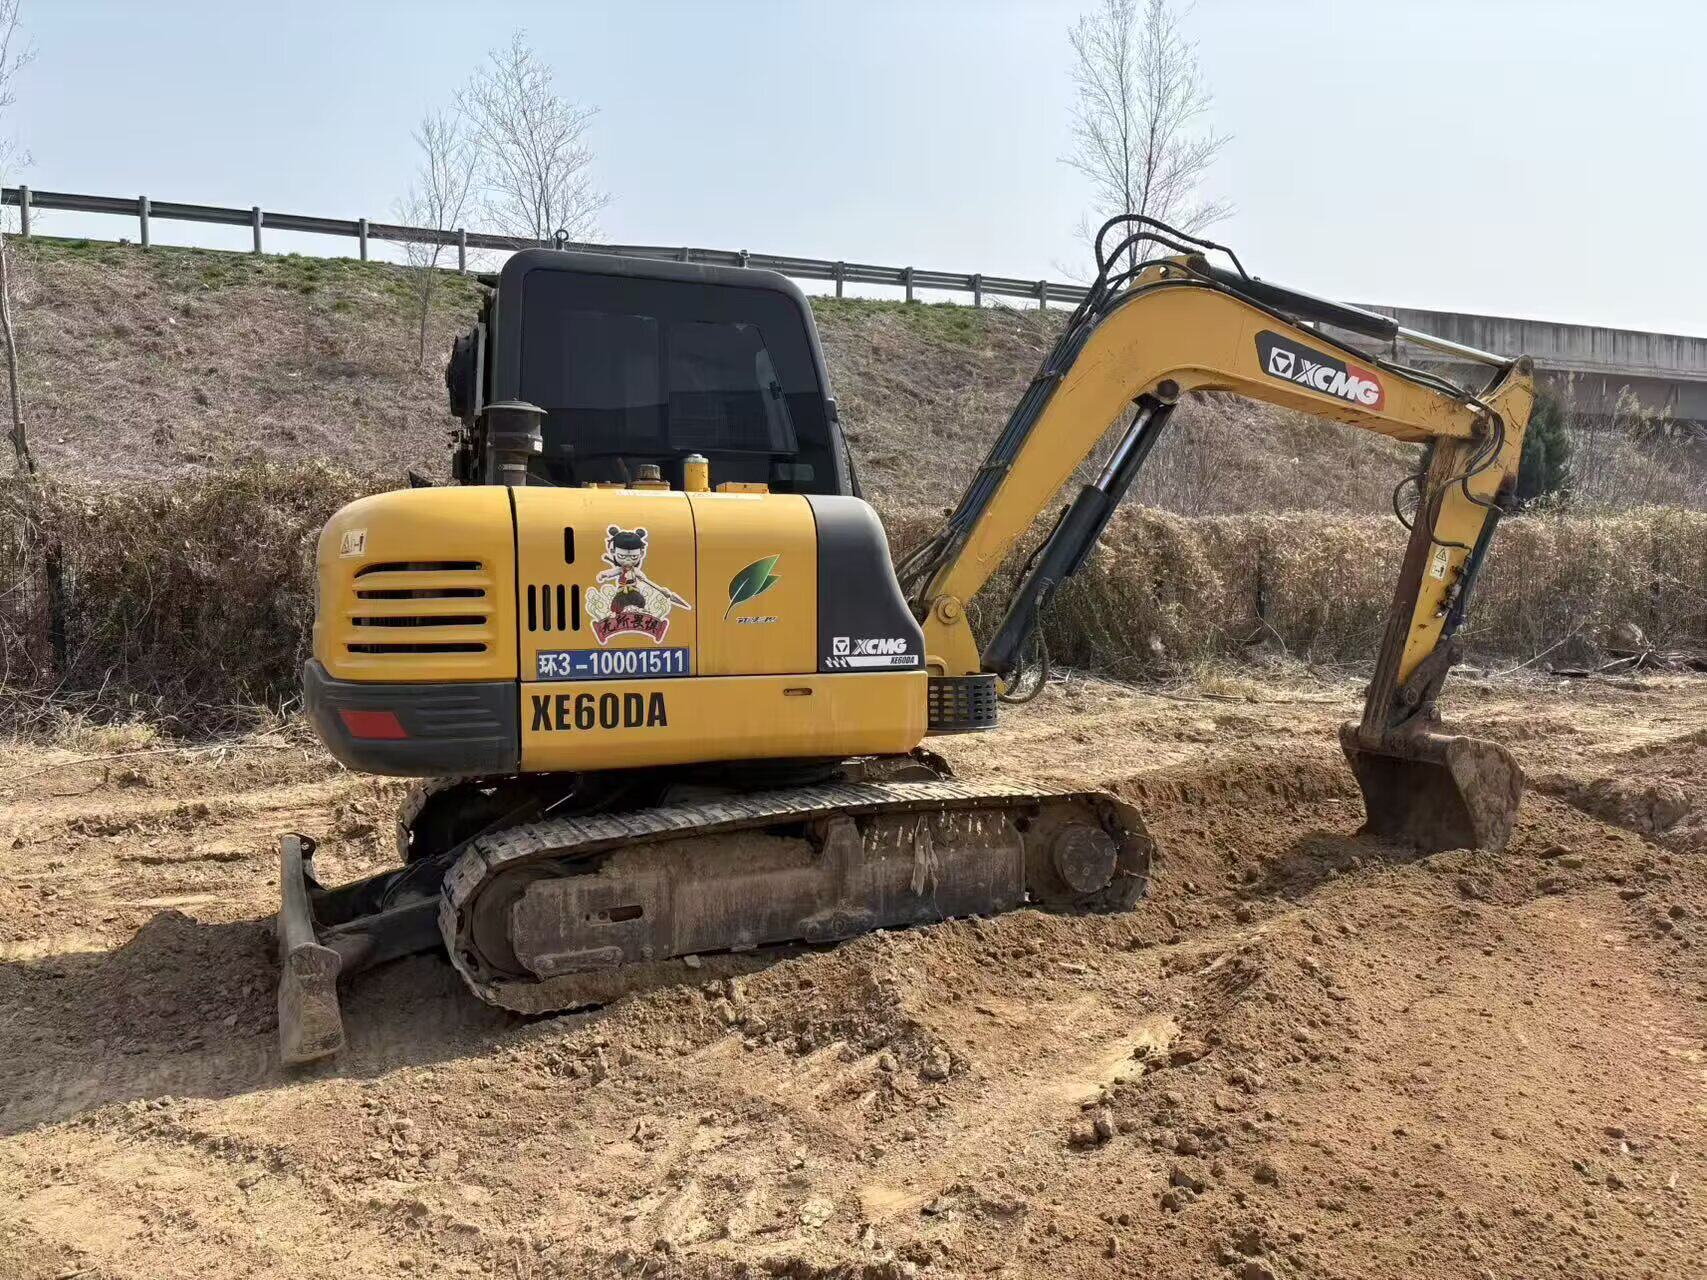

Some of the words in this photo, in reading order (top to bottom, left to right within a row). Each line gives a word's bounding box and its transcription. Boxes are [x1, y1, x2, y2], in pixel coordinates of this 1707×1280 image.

[1292, 358, 1380, 405] XCMG
[851, 638, 907, 655] XCMG
[531, 692, 668, 731] XE60DA
